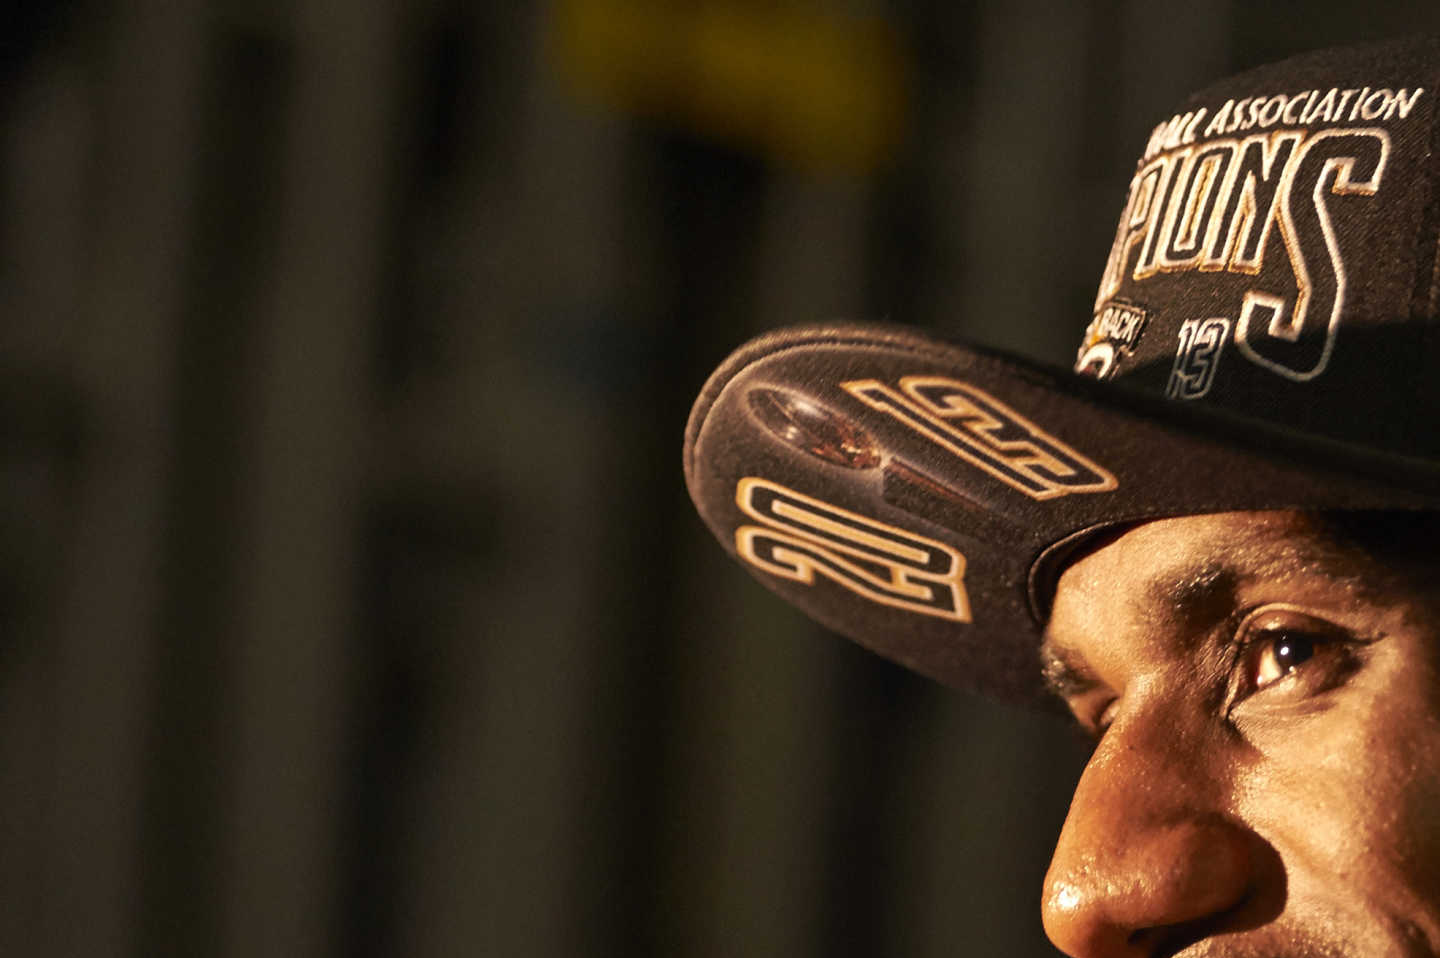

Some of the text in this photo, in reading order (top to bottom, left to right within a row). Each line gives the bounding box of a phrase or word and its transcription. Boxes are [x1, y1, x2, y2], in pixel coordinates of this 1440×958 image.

[1204, 87, 1425, 136] ASSOCIATION
[1095, 127, 1391, 382] PIONS
[1164, 317, 1231, 400] 13
[735, 376, 1119, 623] 20 13
